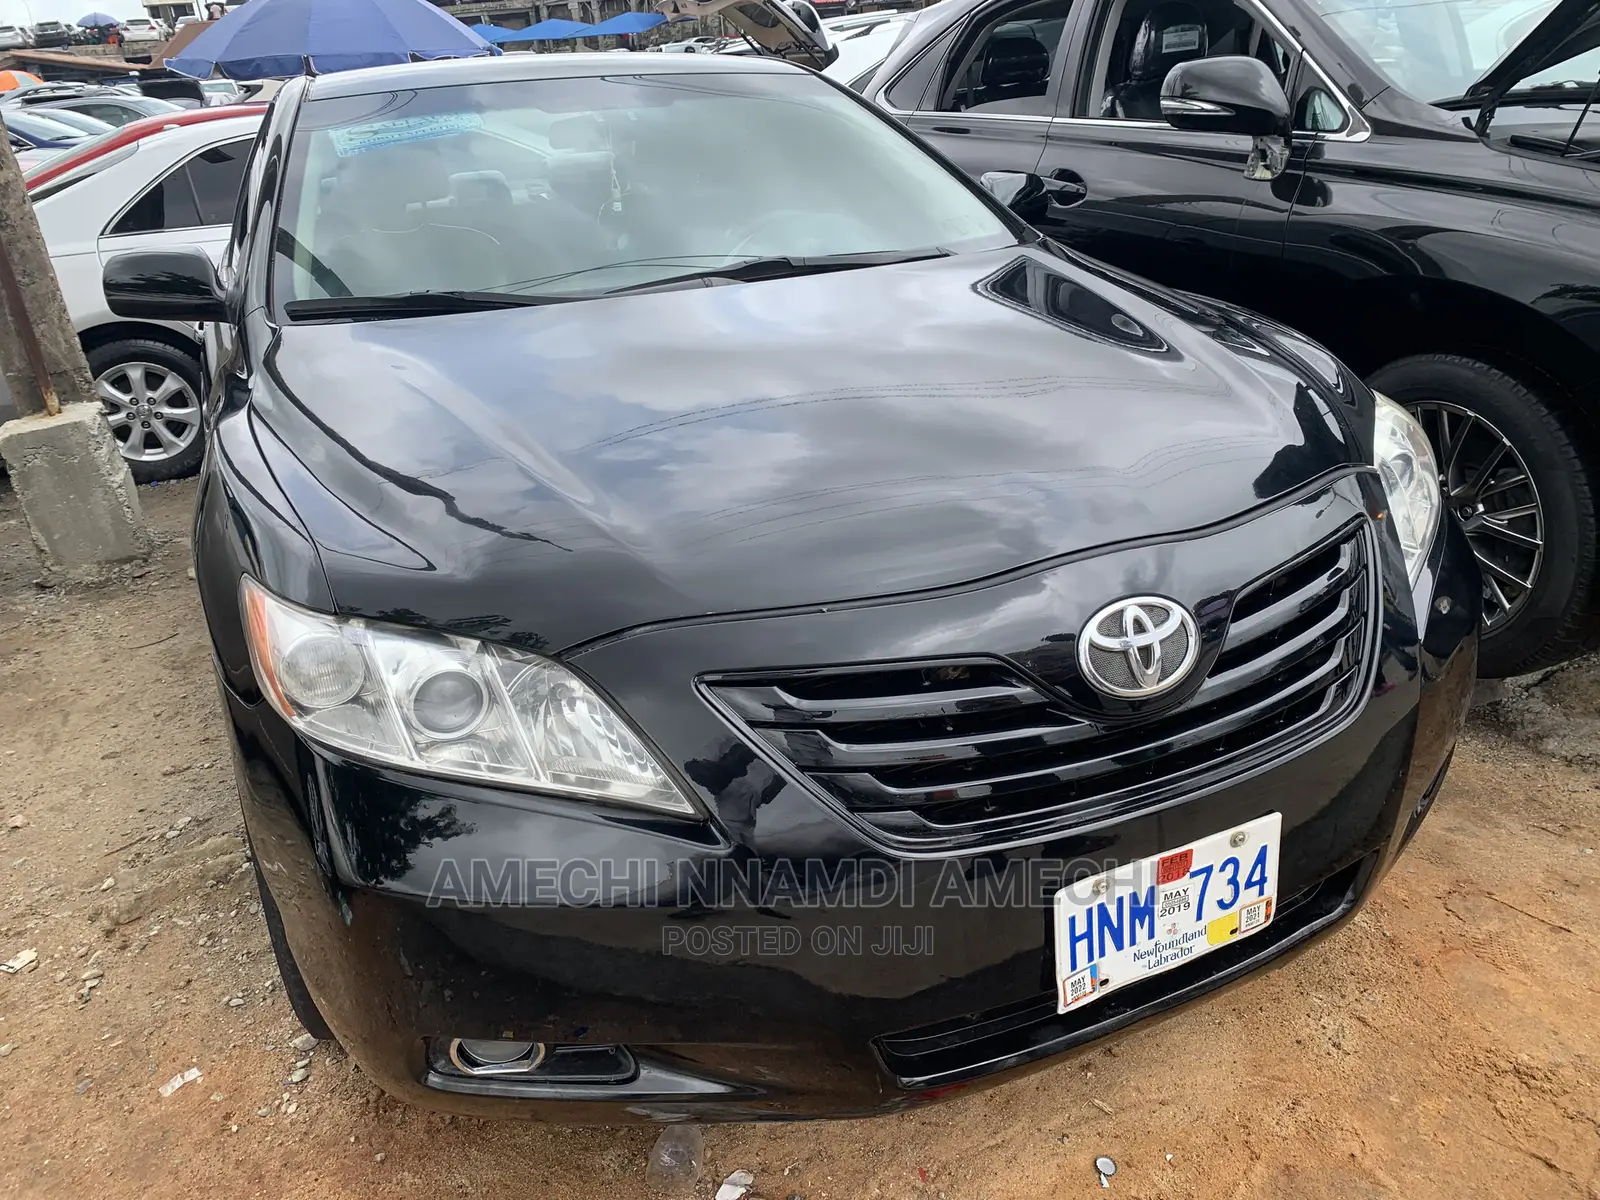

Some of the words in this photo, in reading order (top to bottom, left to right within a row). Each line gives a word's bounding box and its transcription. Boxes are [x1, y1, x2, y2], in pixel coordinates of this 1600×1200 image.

[1161, 853, 1189, 867] FEB
[1163, 887, 1190, 901] MAY
[1069, 885, 1156, 972] HNM
[1189, 844, 1268, 922] 734
[1159, 901, 1191, 918] 2019
[1246, 904, 1261, 916] MAY
[1133, 925, 1207, 962] Newfoundland
[1148, 944, 1195, 970] Labrador
[1070, 975, 1086, 989] MAY
[1070, 983, 1087, 997] 2022
